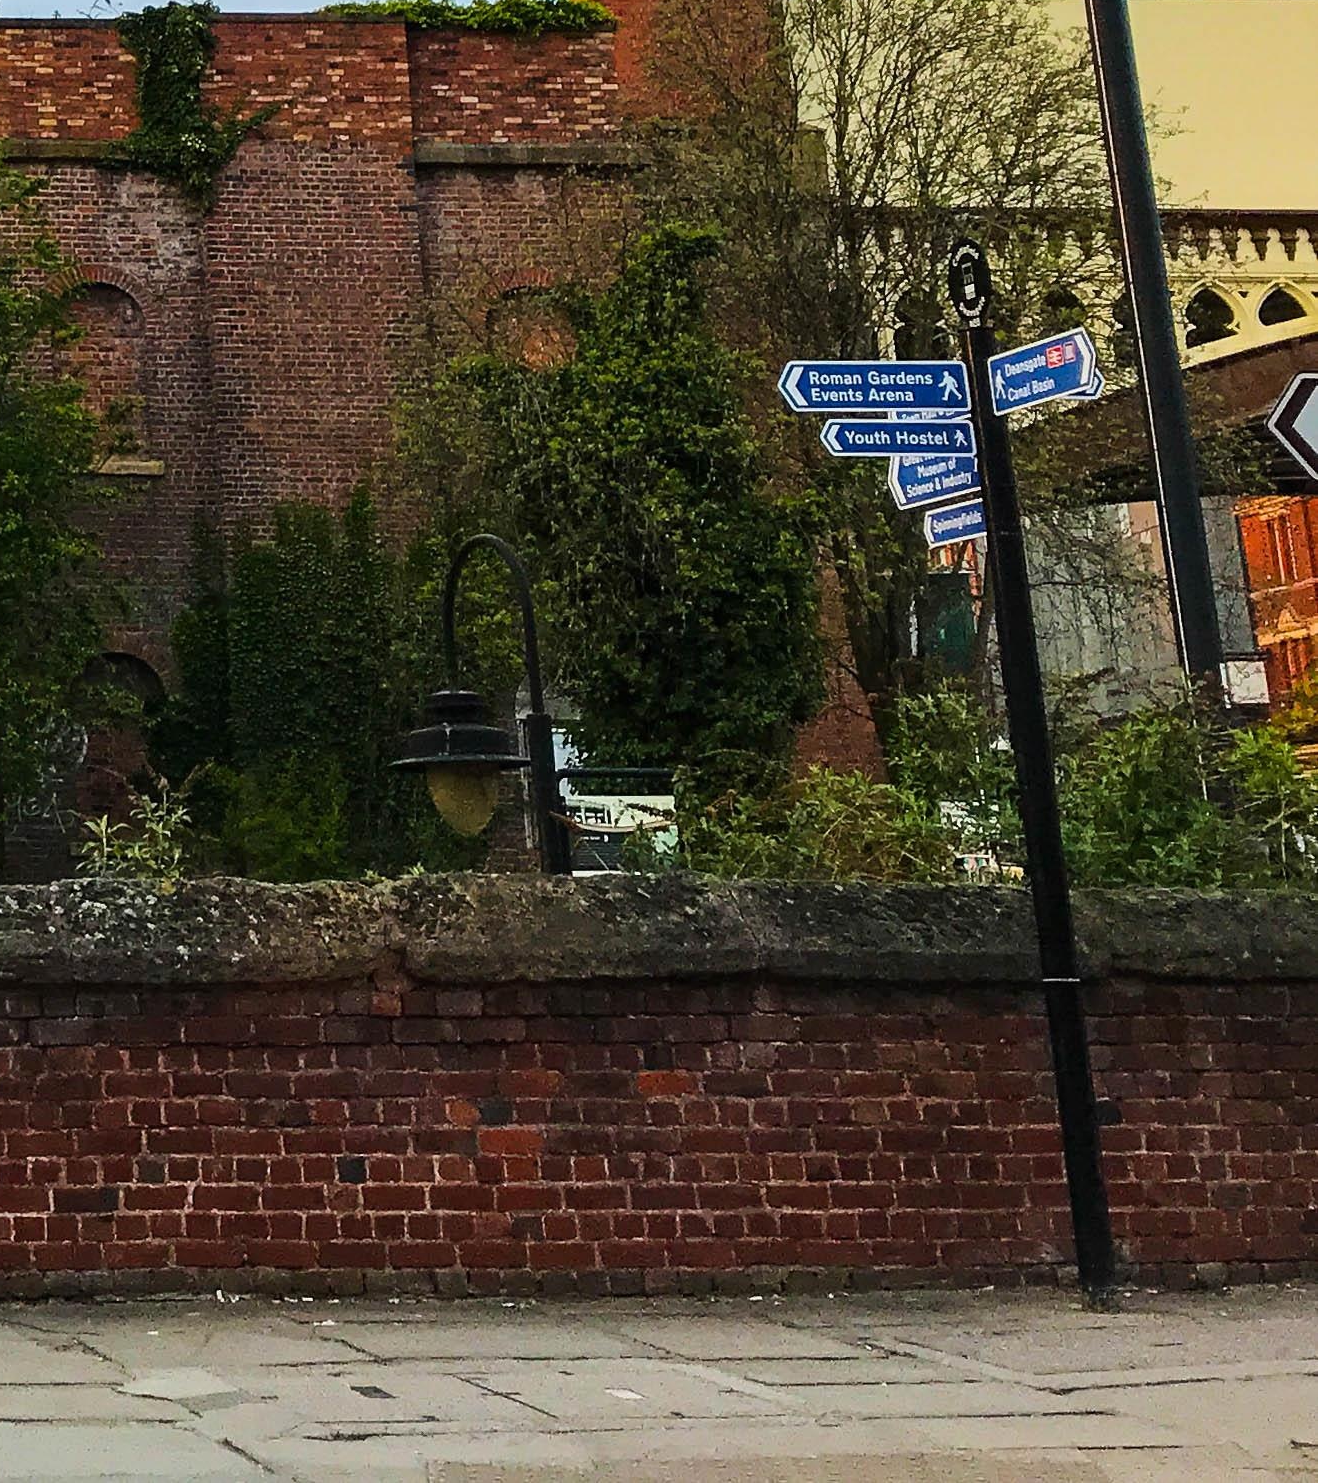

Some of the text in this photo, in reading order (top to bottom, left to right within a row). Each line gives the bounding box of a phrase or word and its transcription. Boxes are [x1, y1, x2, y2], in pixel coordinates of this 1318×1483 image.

[1004, 354, 1046, 377] Deansgate
[809, 370, 933, 385] Roman Gardens
[811, 387, 914, 402] Events Arena
[1007, 377, 1055, 402] Canal Basin
[845, 431, 950, 446] Youth Hostel
